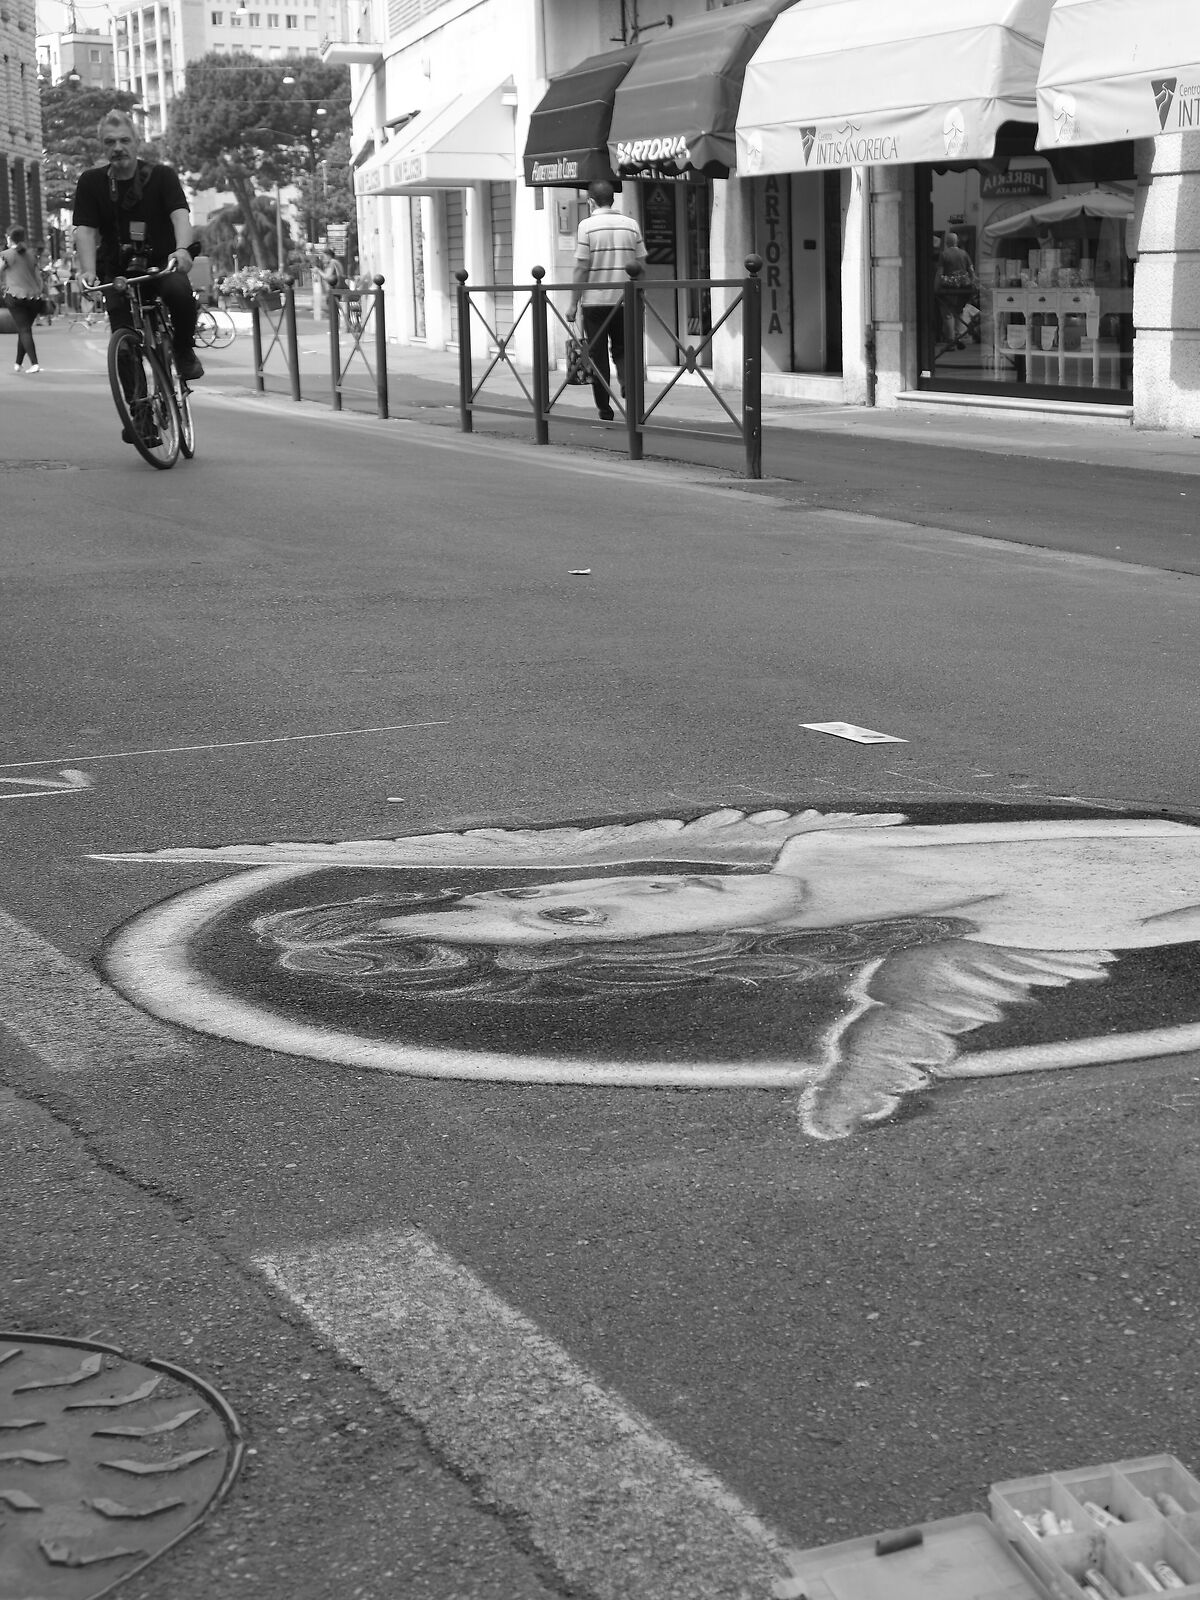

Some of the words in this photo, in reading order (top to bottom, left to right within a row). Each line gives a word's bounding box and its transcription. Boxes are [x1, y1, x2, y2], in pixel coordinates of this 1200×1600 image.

[1179, 84, 1200, 97] Centro
[616, 136, 691, 164] SARTORIA
[816, 136, 899, 165] INTISANOREICA
[765, 174, 783, 334] ARTORIA
